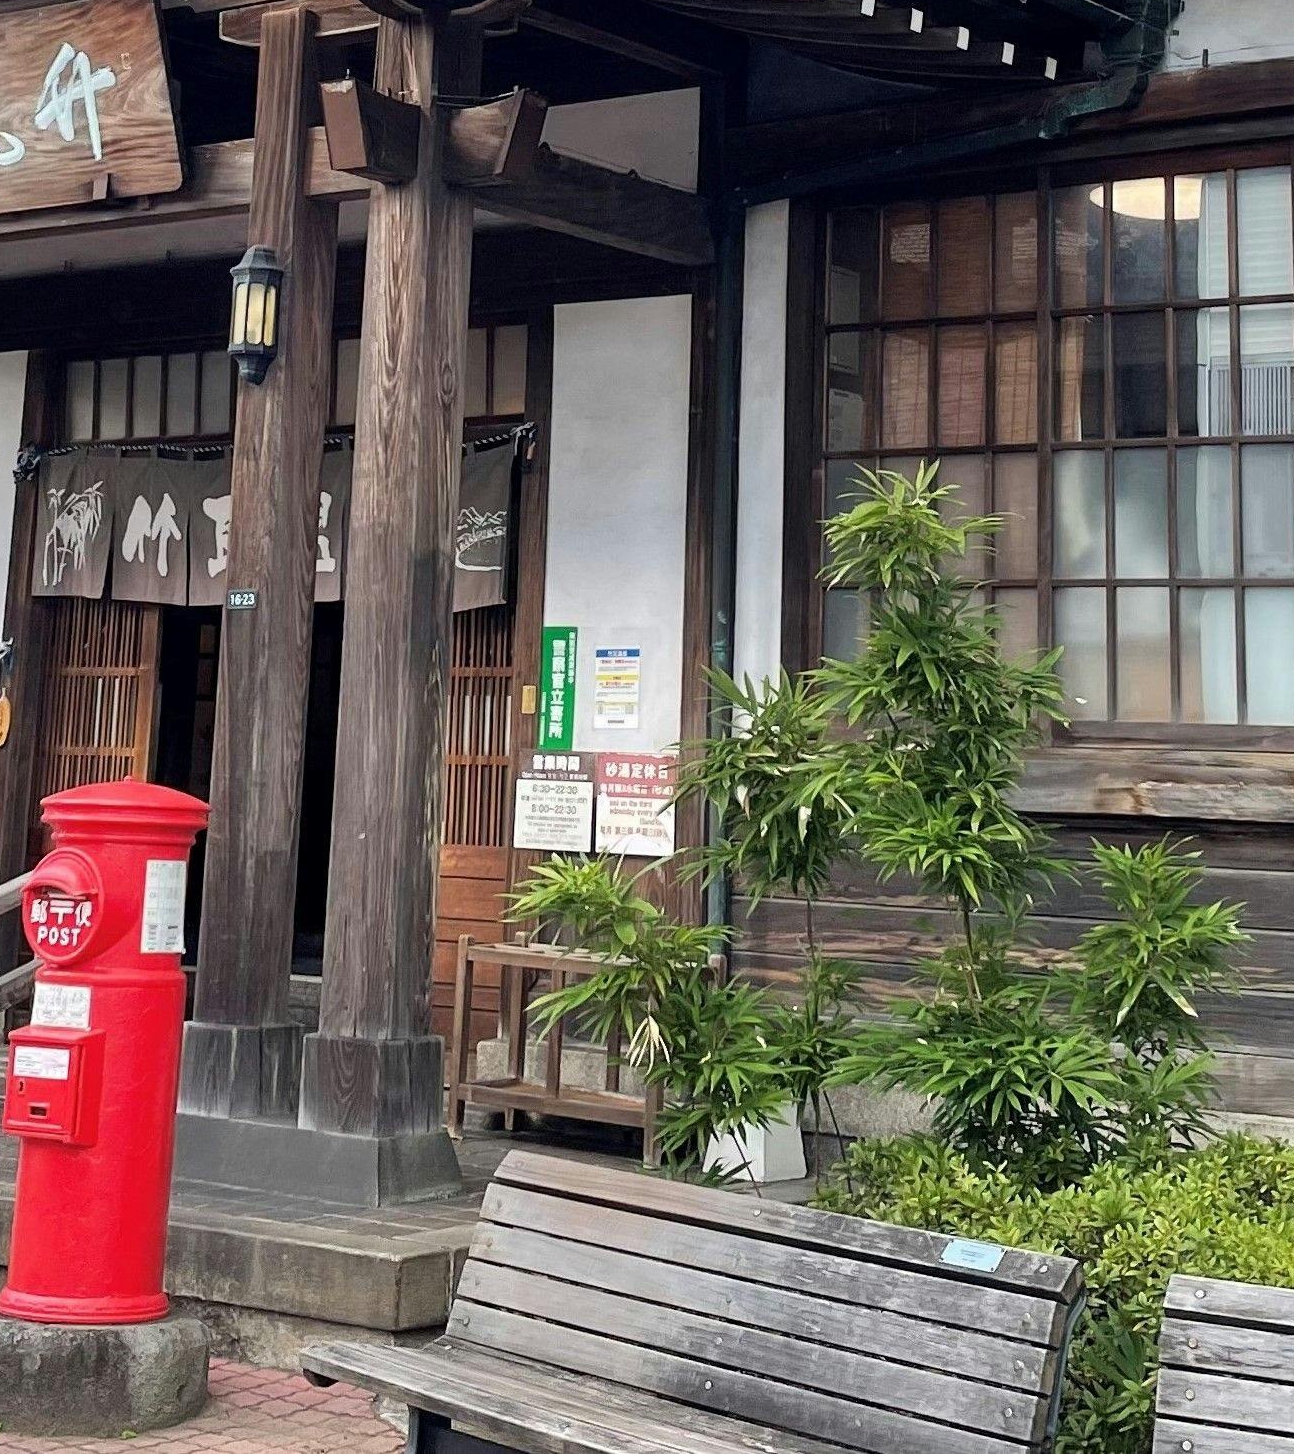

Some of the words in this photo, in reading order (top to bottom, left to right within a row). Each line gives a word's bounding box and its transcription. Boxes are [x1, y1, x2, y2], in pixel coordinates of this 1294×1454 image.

[605, 761, 668, 780] 砂湯定休日
[36, 925, 81, 947] POST
